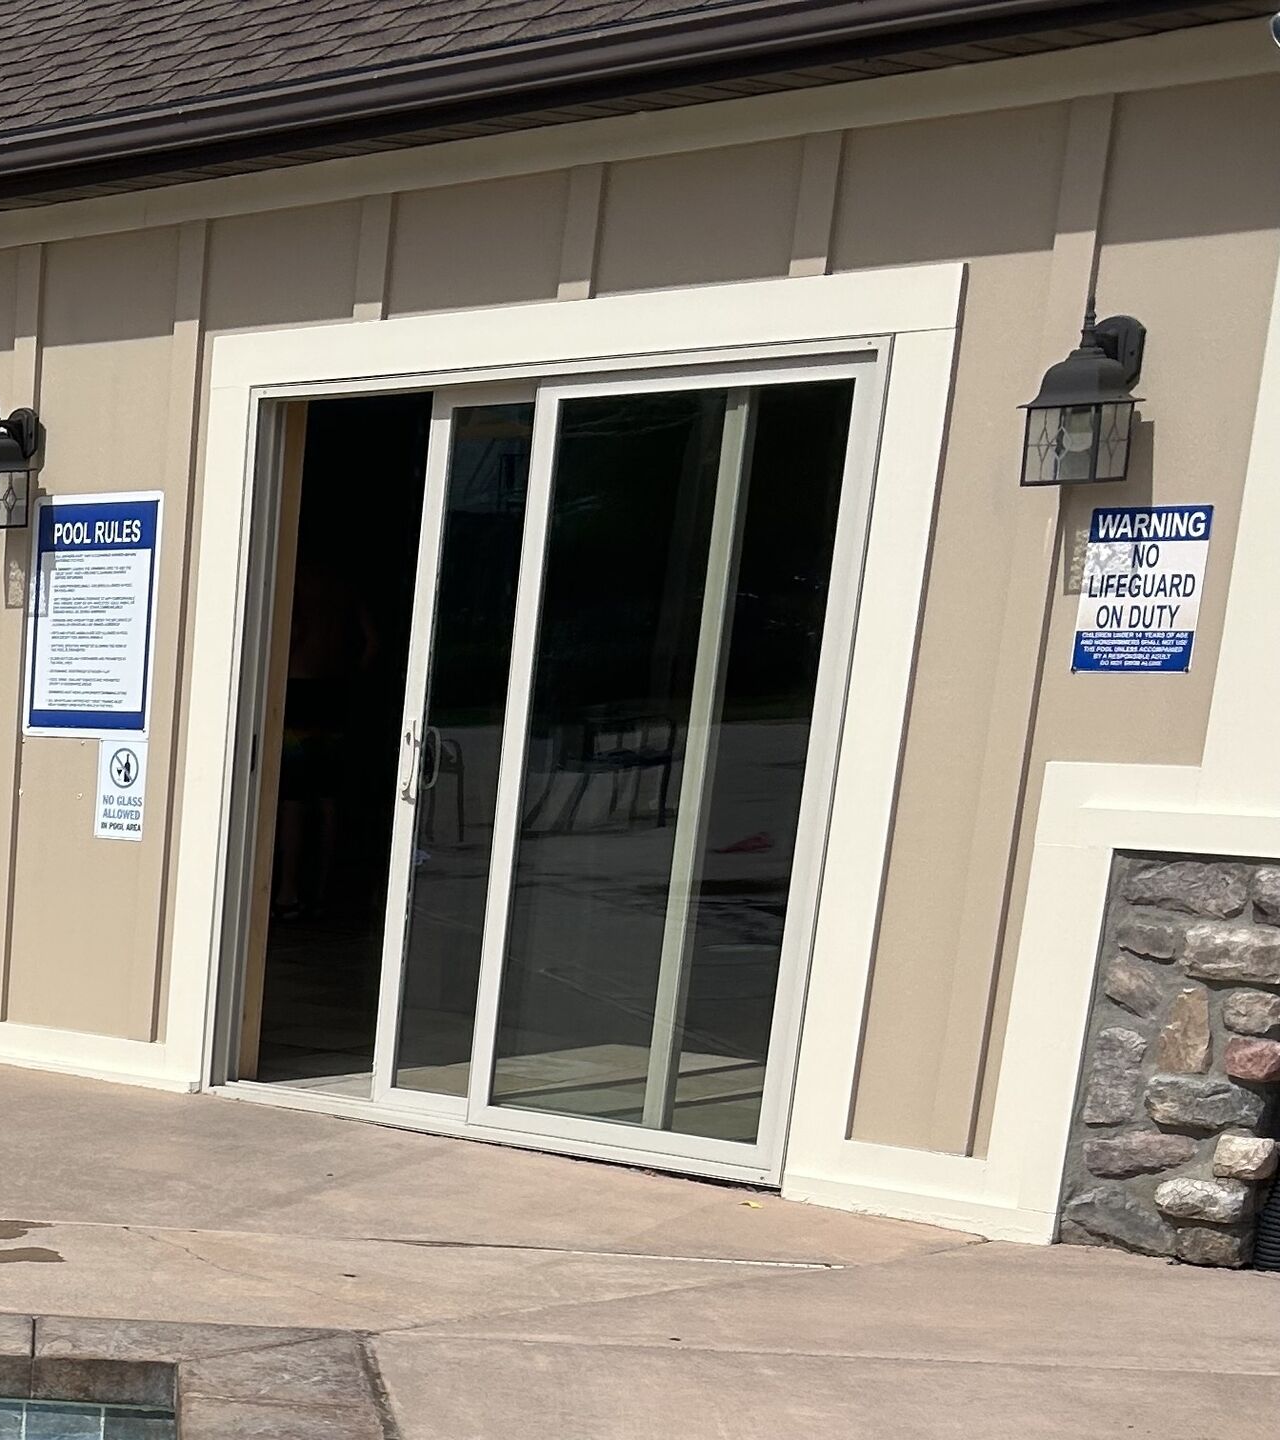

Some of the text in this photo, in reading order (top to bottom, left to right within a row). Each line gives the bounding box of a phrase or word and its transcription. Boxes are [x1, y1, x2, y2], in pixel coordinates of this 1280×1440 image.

[53, 519, 141, 545] POOL RULES
[1098, 511, 1207, 539] WARNING
[1131, 543, 1160, 569] NO
[1088, 573, 1196, 598] LIFEGUARD
[1096, 605, 1181, 629] ON DUTY
[102, 795, 143, 807] NO GLASS
[102, 808, 140, 820] ALLOWED
